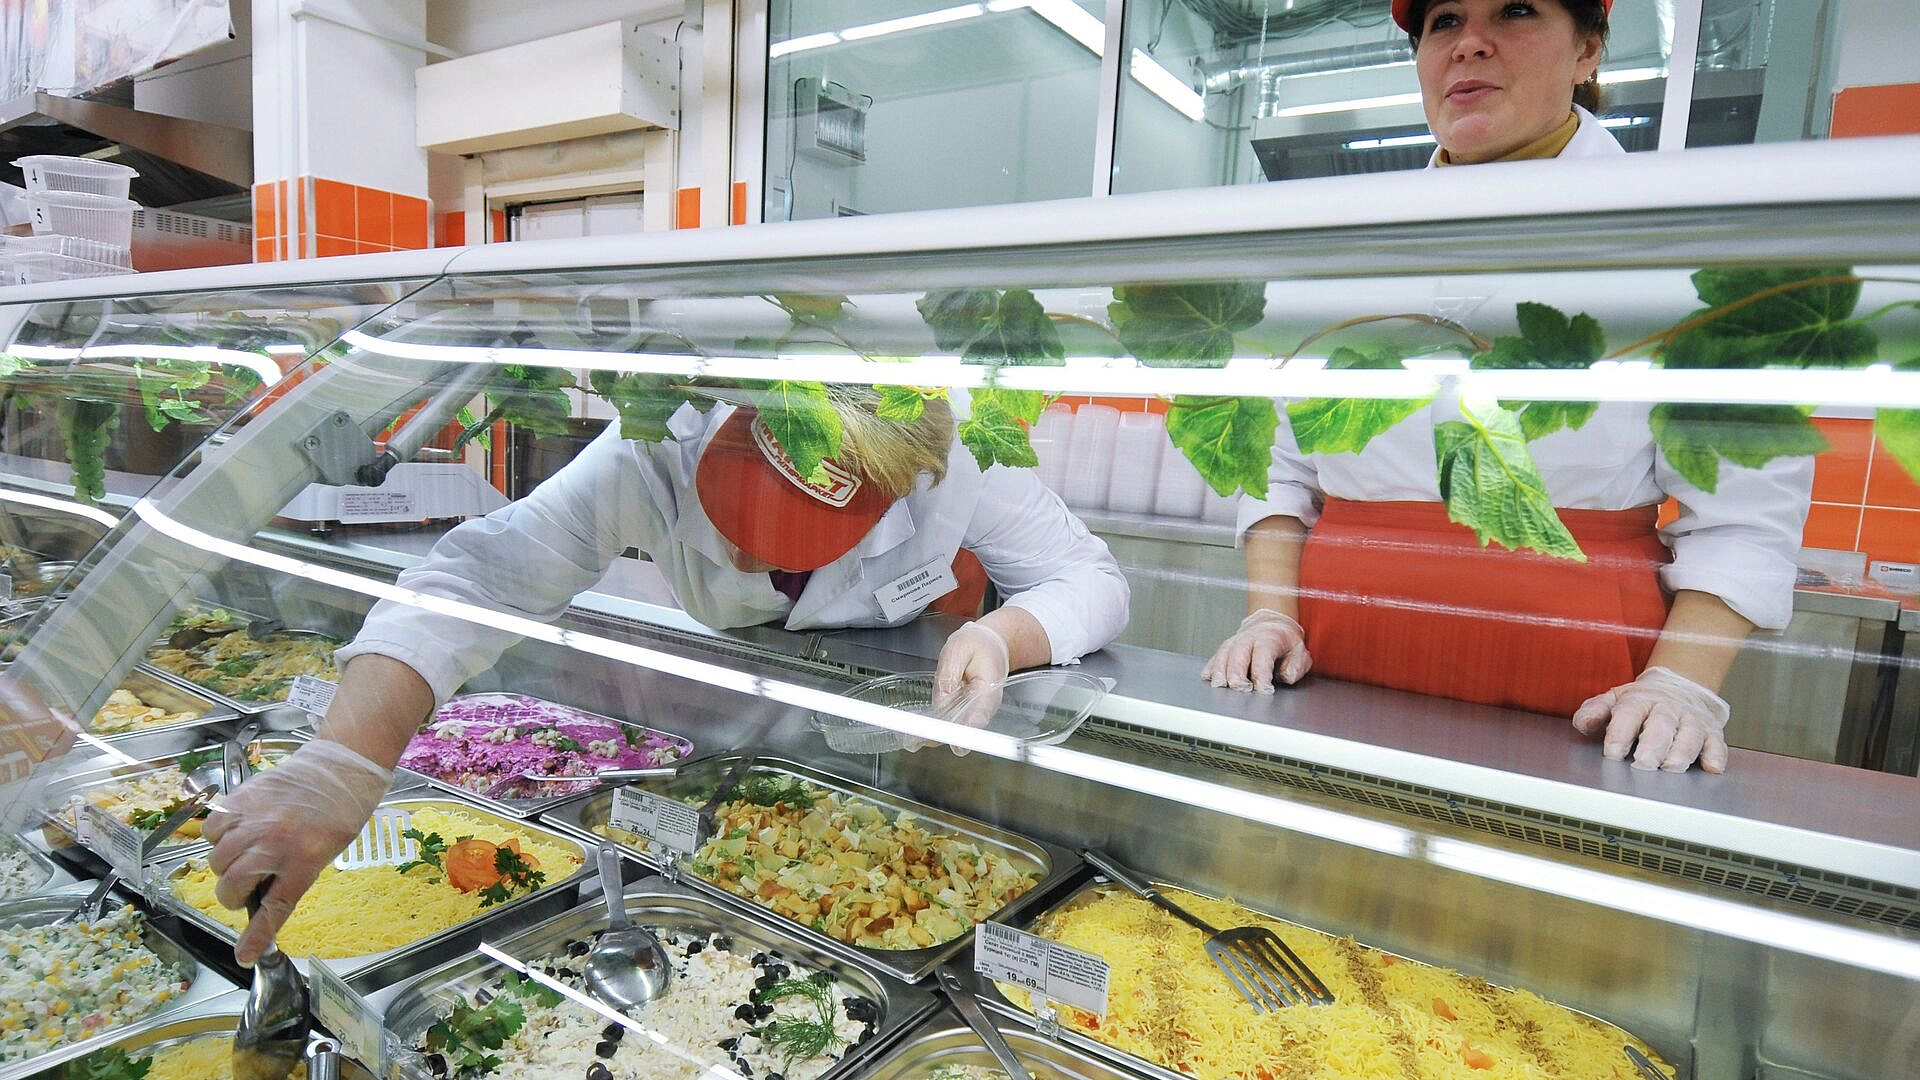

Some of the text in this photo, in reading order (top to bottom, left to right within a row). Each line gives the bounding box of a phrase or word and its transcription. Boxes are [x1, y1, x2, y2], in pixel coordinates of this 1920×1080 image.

[32, 167, 38, 184] 4
[36, 208, 43, 224] 5
[774, 454, 836, 500] ГИПЕРМАРКЕТ
[891, 575, 943, 603] Смирнова Лариса
[1006, 971, 1017, 982] 19
[1025, 977, 1036, 988] 69
